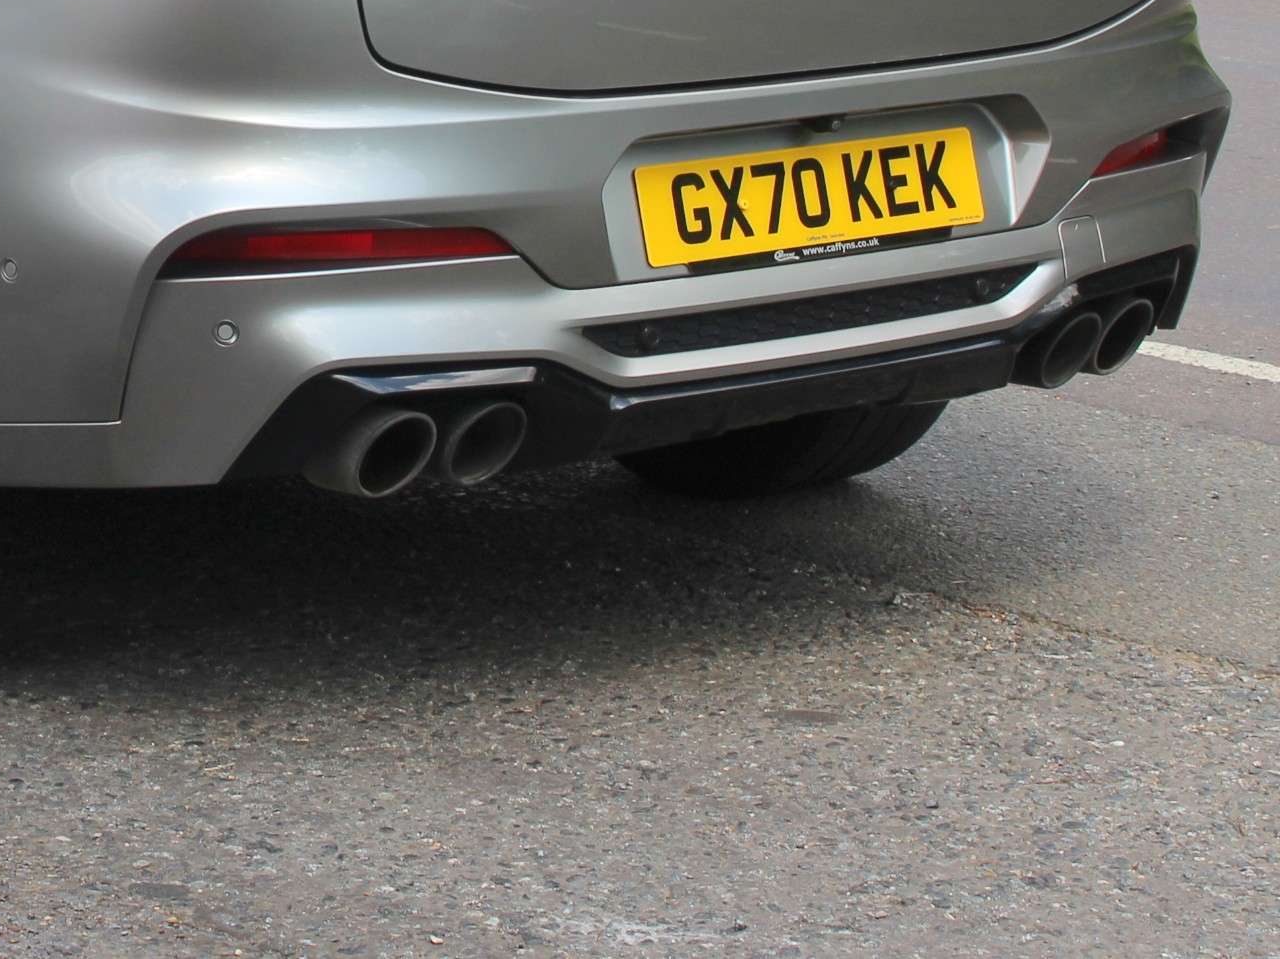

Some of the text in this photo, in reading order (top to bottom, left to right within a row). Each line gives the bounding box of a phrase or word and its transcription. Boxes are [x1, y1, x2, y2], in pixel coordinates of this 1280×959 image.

[671, 140, 957, 244] GX70 KEK
[802, 237, 879, 256] www.caffyns.co.uk
